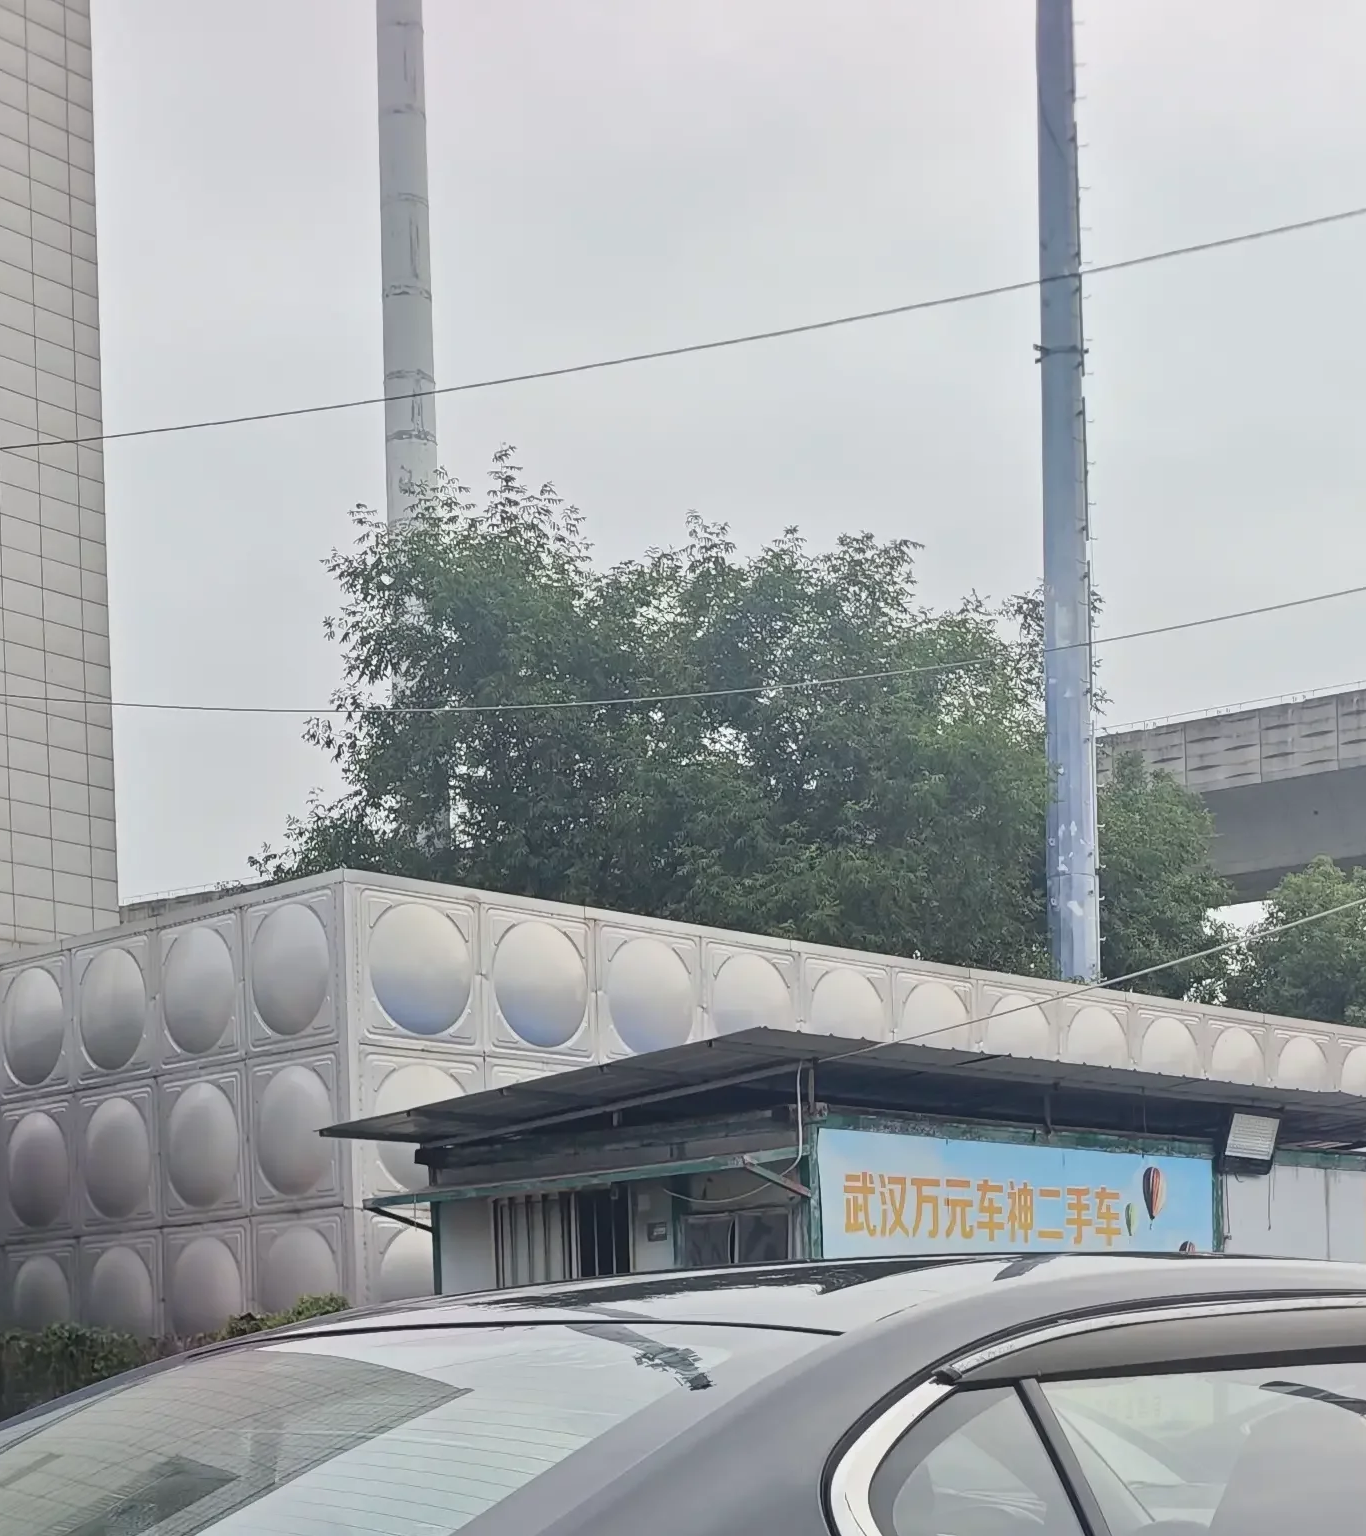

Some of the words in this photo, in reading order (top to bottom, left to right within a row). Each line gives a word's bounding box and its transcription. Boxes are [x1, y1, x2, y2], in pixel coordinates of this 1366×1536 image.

[843, 1171, 1122, 1246] 武汉万元车神二手车
